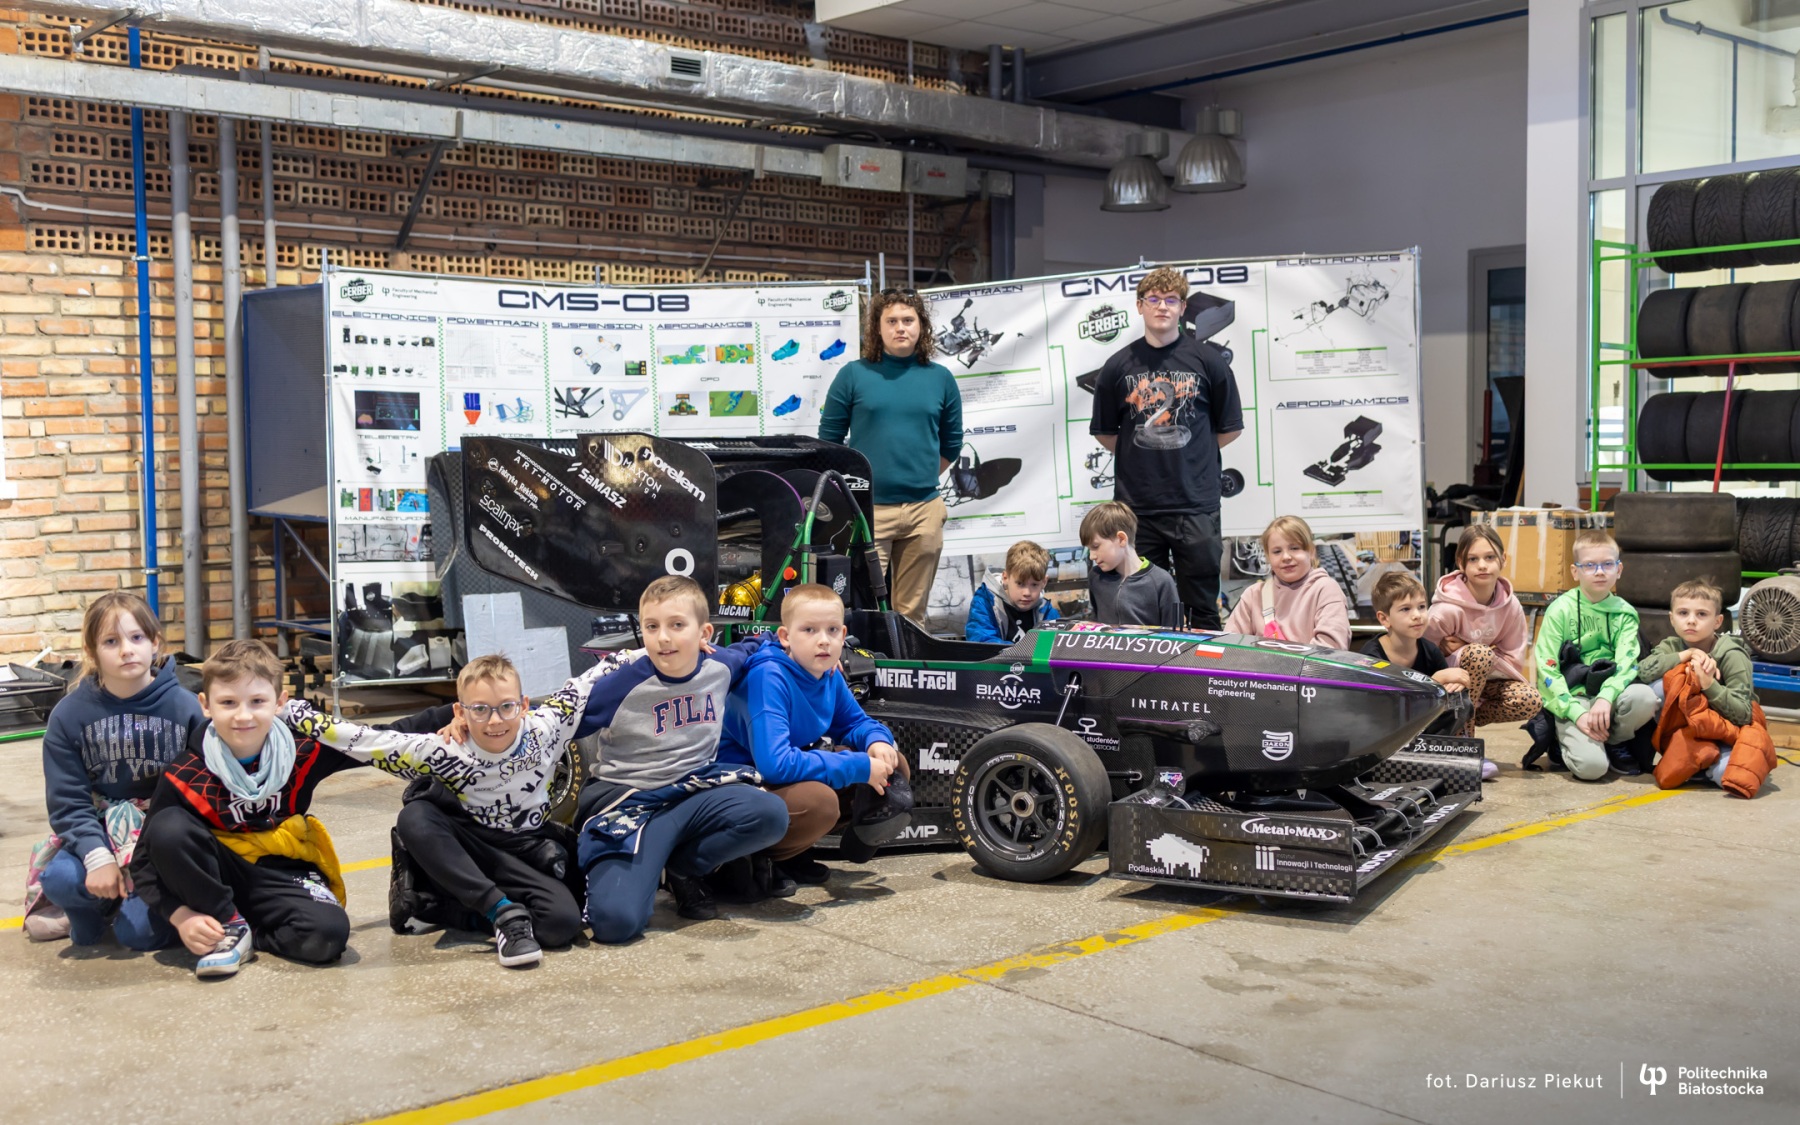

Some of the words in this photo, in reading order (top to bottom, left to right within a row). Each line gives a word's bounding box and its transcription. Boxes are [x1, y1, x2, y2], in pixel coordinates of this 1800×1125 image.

[1276, 254, 1400, 267] ELECTRONICS
[1061, 265, 1248, 298] CMS08
[340, 283, 373, 299] CERBER
[498, 289, 690, 312] CMS-08
[823, 294, 852, 309] CERBER
[332, 310, 437, 322] ELECTRONICS
[446, 317, 539, 328] POWERTRAIN
[552, 322, 643, 330] SUSPENSION
[656, 322, 752, 330] AERODYNAMICS
[780, 320, 841, 328] CHASSIS
[1078, 310, 1130, 339] CERBER
[1276, 396, 1409, 410] AERODYNAMICS
[964, 424, 1017, 435] ASSIS
[642, 448, 706, 502] norelem
[514, 456, 582, 511] ART-MOTOR
[578, 468, 627, 509] SaMASZ
[478, 524, 539, 580] PROMOTECH
[719, 605, 750, 617] lidCAM
[738, 624, 750, 634] LV
[1056, 633, 1080, 648] TU
[1083, 634, 1188, 655] BIALYSTOK
[1208, 677, 1238, 689] Faculty
[1239, 680, 1248, 688] of
[1249, 680, 1297, 692] Mechanical
[976, 684, 1041, 700] BIANAR
[1208, 688, 1256, 700] Engineering
[1131, 698, 1211, 714] INTRATEL
[652, 692, 718, 737] FILA
[1086, 736, 1119, 744] studentów
[1264, 740, 1290, 748] JAZON
[1428, 744, 1478, 754] SOLIDWORKS
[1128, 864, 1165, 875] Podlaskie
[1276, 859, 1310, 869] Innowacji
[1314, 861, 1353, 872] Technologii
